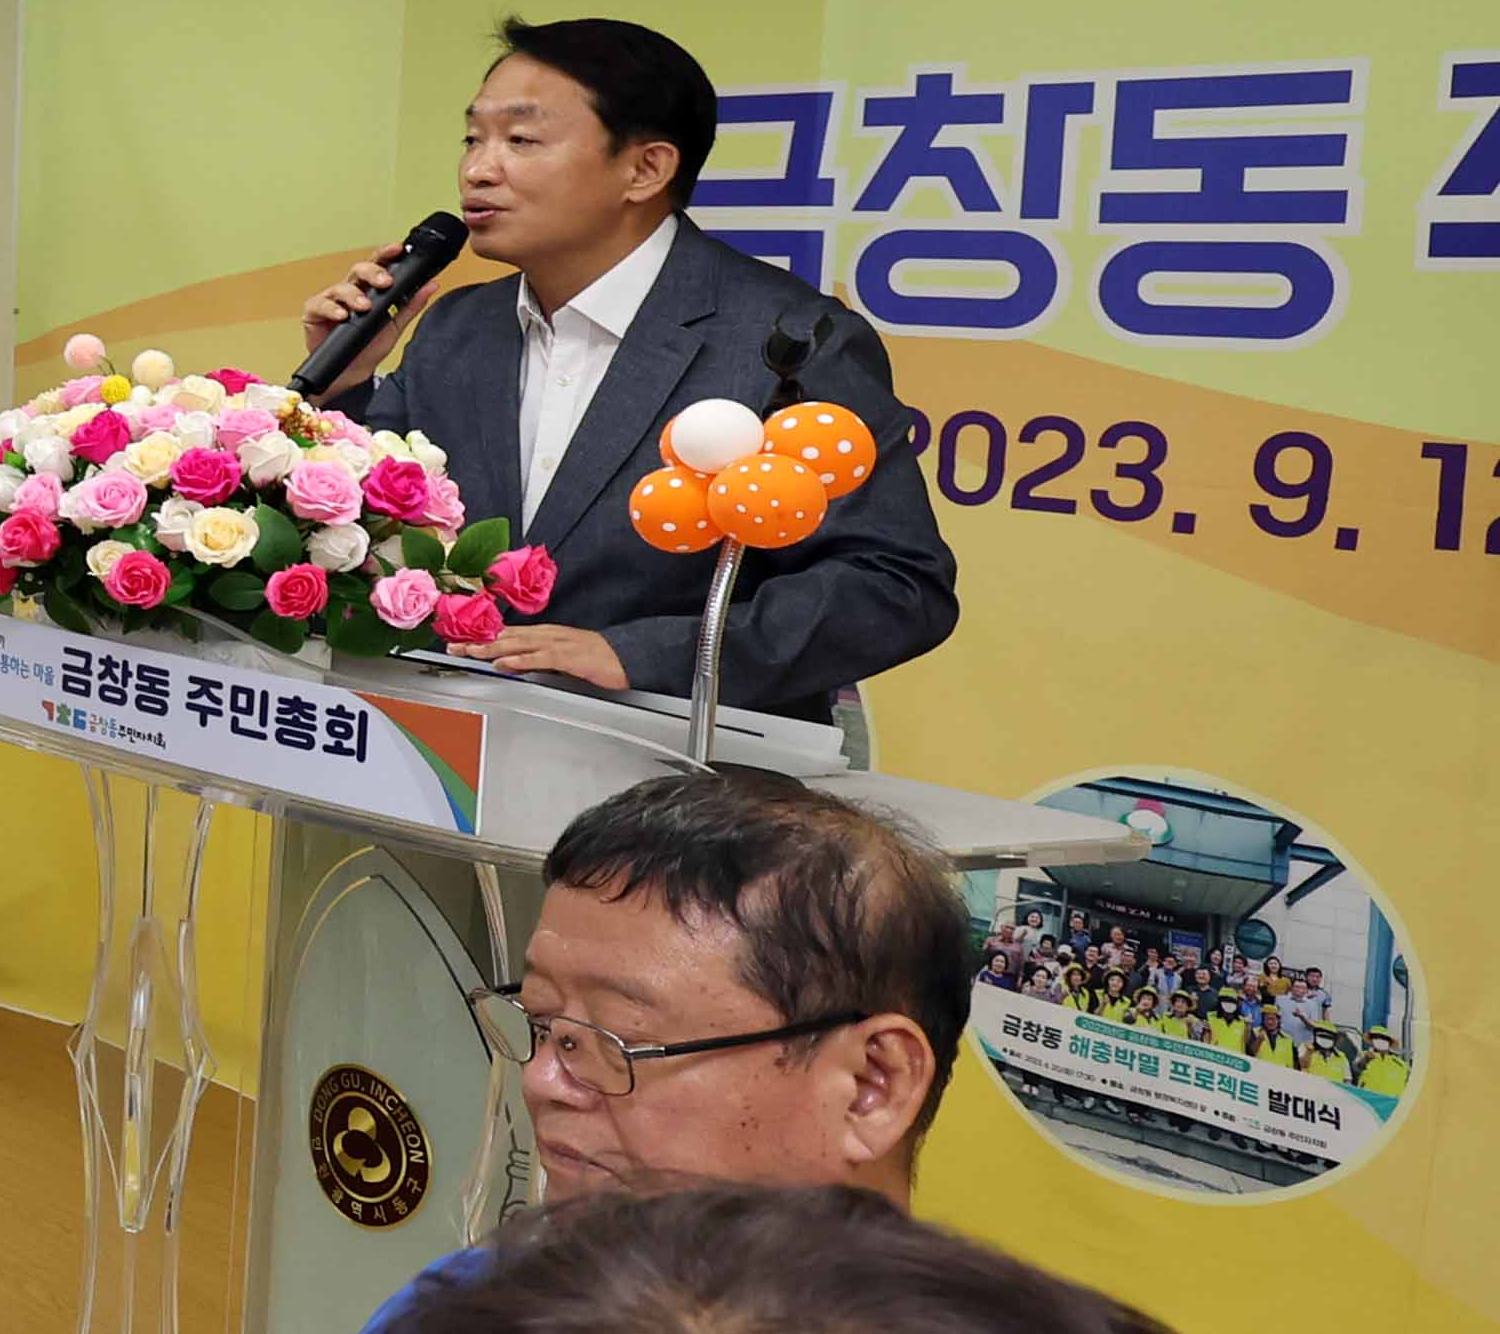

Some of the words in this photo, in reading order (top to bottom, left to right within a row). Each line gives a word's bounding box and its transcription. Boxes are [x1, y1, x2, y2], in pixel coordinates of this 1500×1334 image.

[690, 70, 1353, 340] 금창동
[1248, 430, 1360, 551] 9.
[61, 646, 171, 717] 금창동
[184, 672, 370, 765] 주민총회
[369, 1081, 426, 1165] INCHEON
[1002, 1013, 1063, 1051] 금창동
[1068, 1034, 1161, 1079] 해충박멸
[1168, 1060, 1260, 1107] 프로젝트
[1267, 1088, 1342, 1132] 발대식
